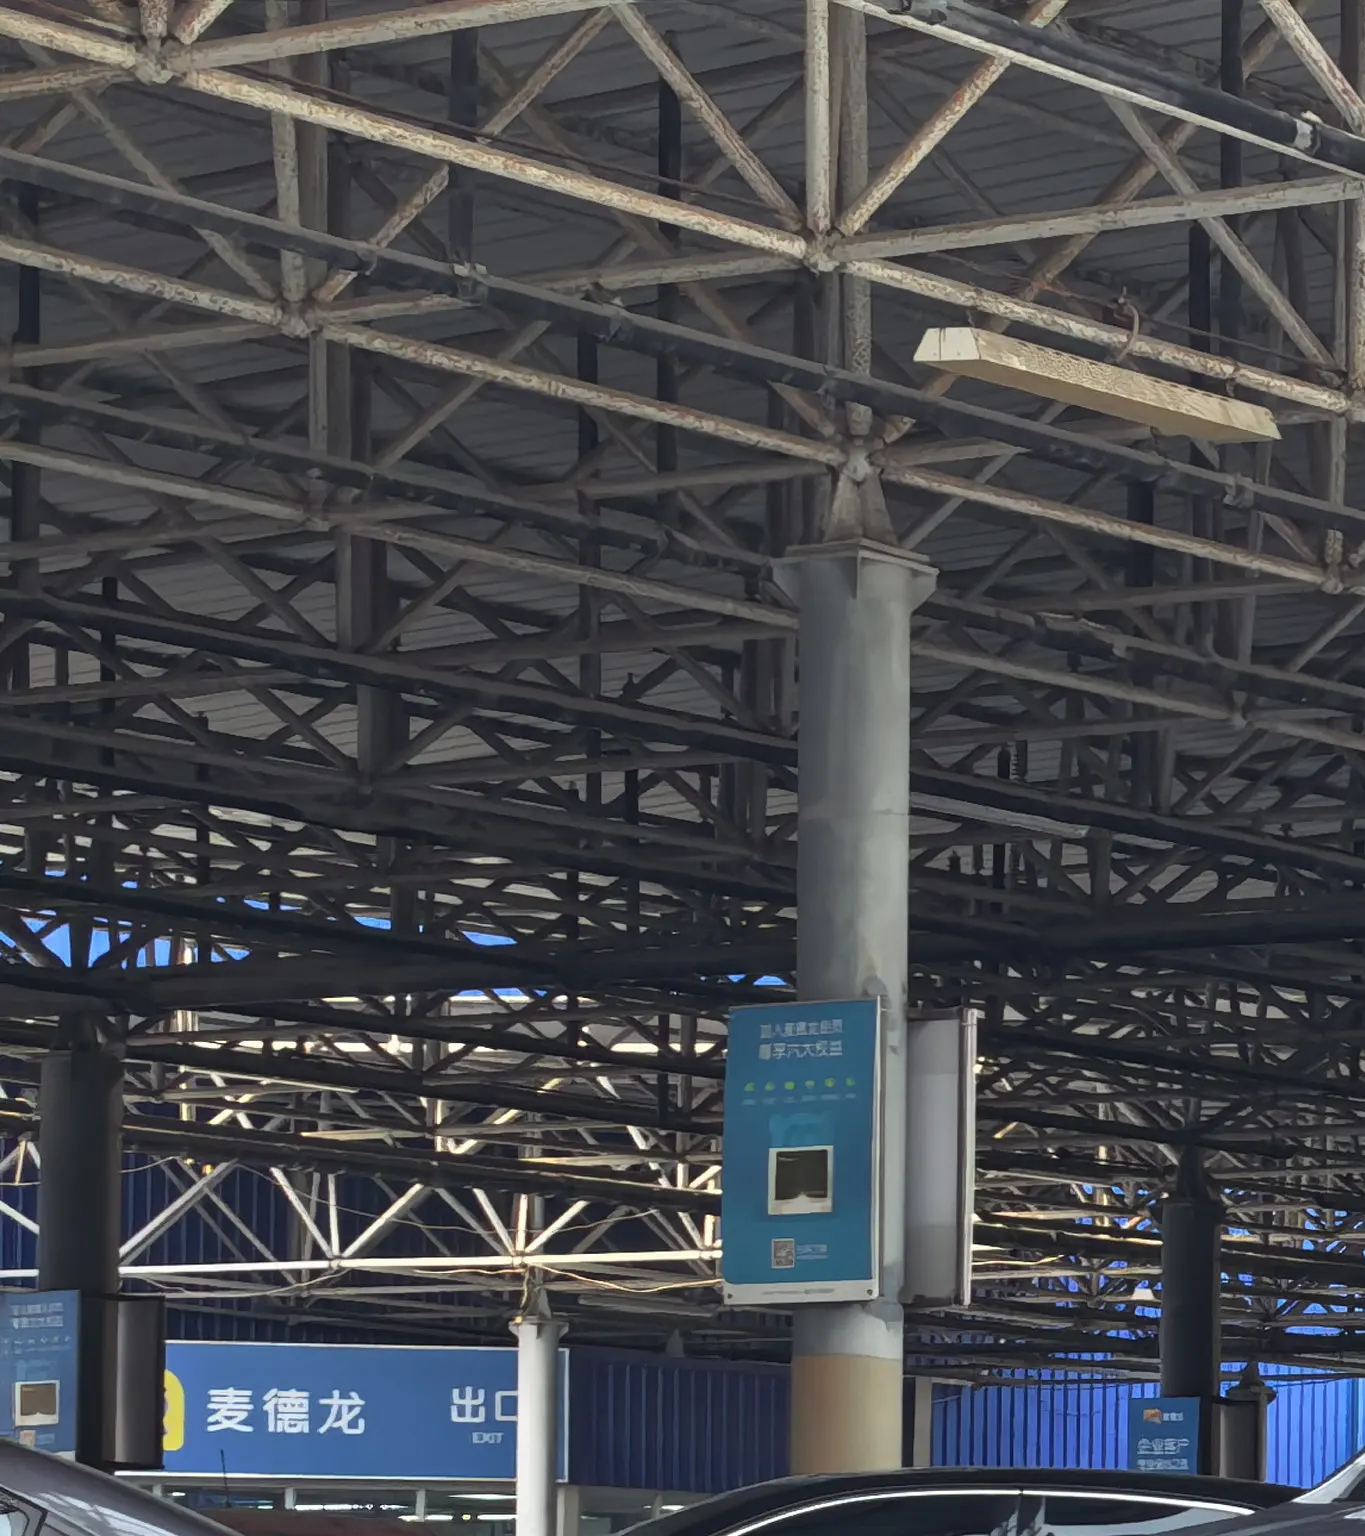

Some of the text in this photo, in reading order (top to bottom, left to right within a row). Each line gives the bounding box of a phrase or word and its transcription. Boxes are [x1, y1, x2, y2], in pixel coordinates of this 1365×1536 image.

[206, 1387, 366, 1434] 麦德龙
[450, 1386, 518, 1423] 出口
